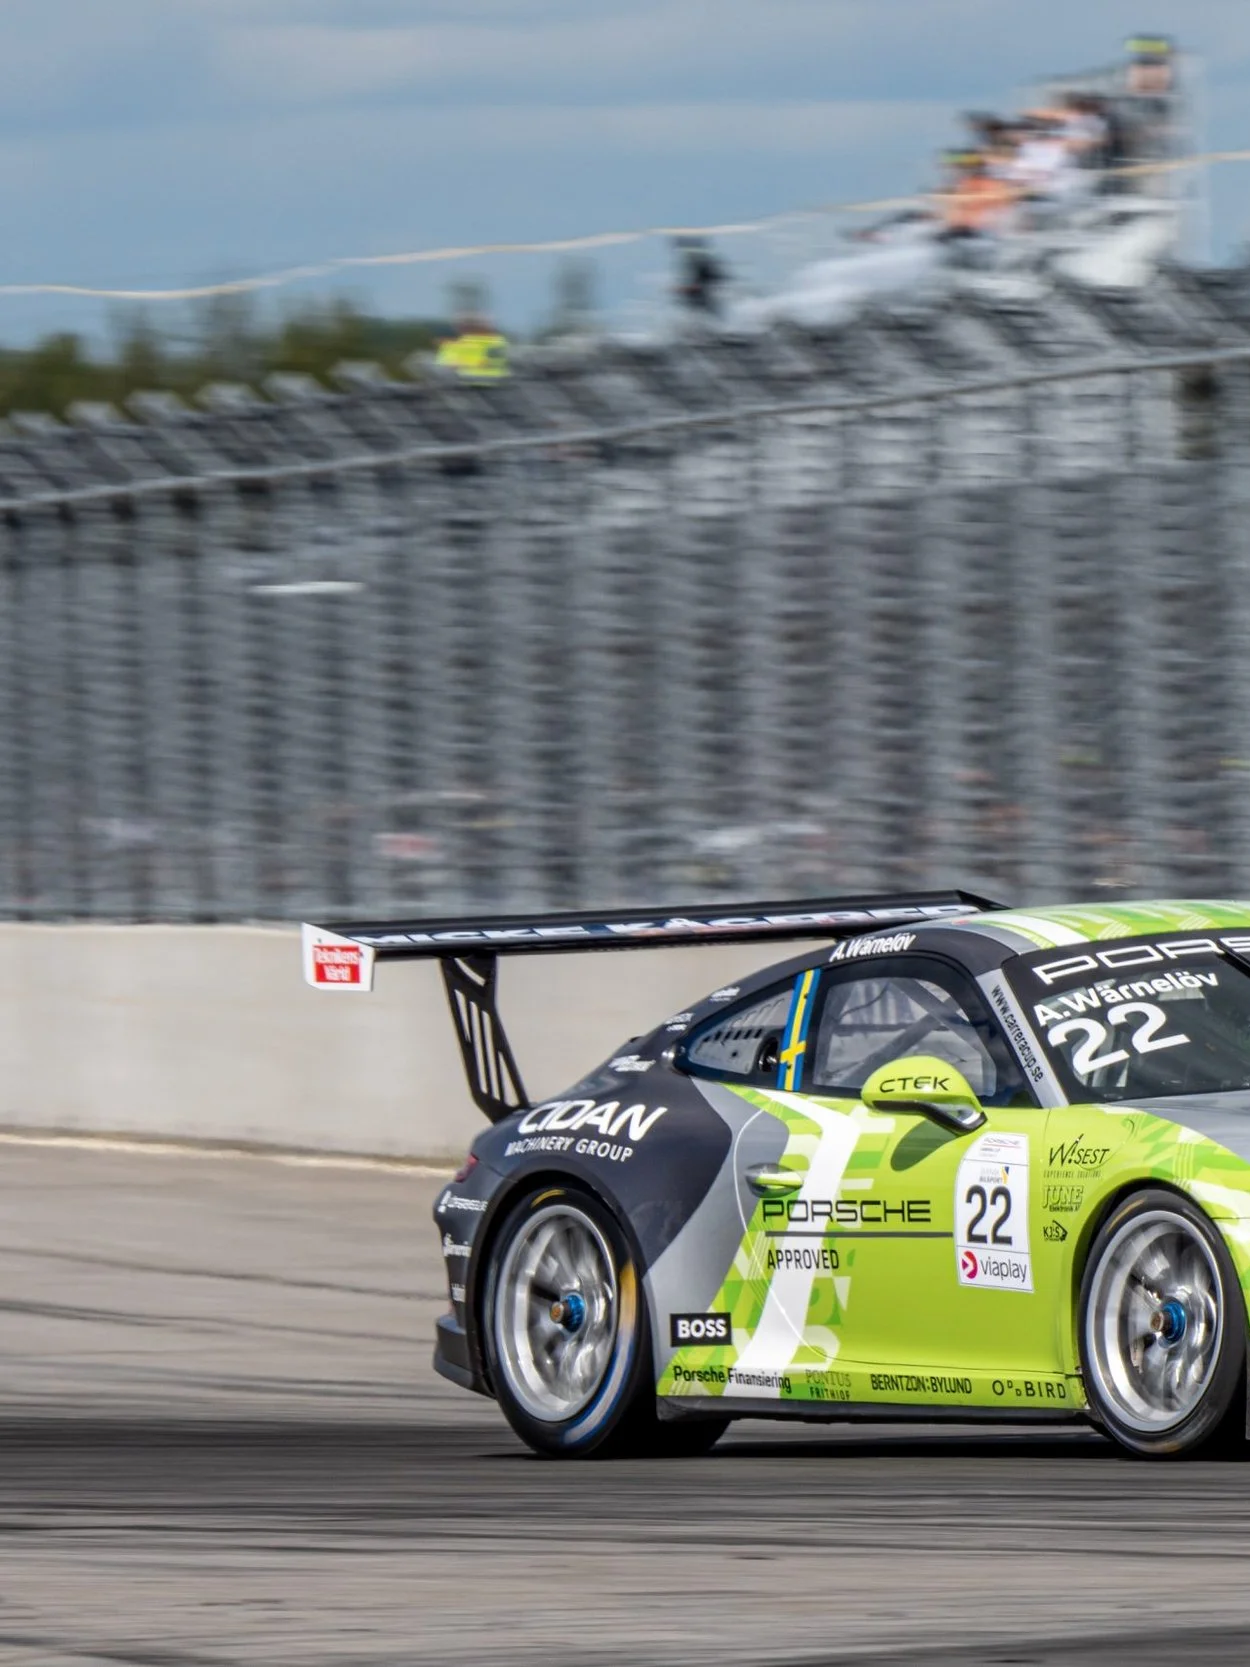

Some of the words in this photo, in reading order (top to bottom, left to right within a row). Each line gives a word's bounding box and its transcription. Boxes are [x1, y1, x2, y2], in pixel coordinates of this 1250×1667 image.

[1033, 970, 1219, 1027] A.Wärnelöv
[991, 984, 1044, 1083] www.carreracup.se
[1047, 1001, 1192, 1076] 22
[879, 1076, 951, 1093] CTEK
[517, 1099, 668, 1142] CIDAN
[504, 1136, 575, 1157] MACHINERY
[575, 1138, 634, 1163] GROUP
[1042, 1184, 1084, 1210] JUNE
[763, 1200, 932, 1223] PORSCHE
[965, 1184, 1012, 1245] 22
[766, 1249, 840, 1271] APPROVED
[980, 1256, 1027, 1283] viaplay
[677, 1318, 727, 1338] BOSS
[673, 1365, 726, 1383] Porsche
[726, 1367, 792, 1394] Finansiering
